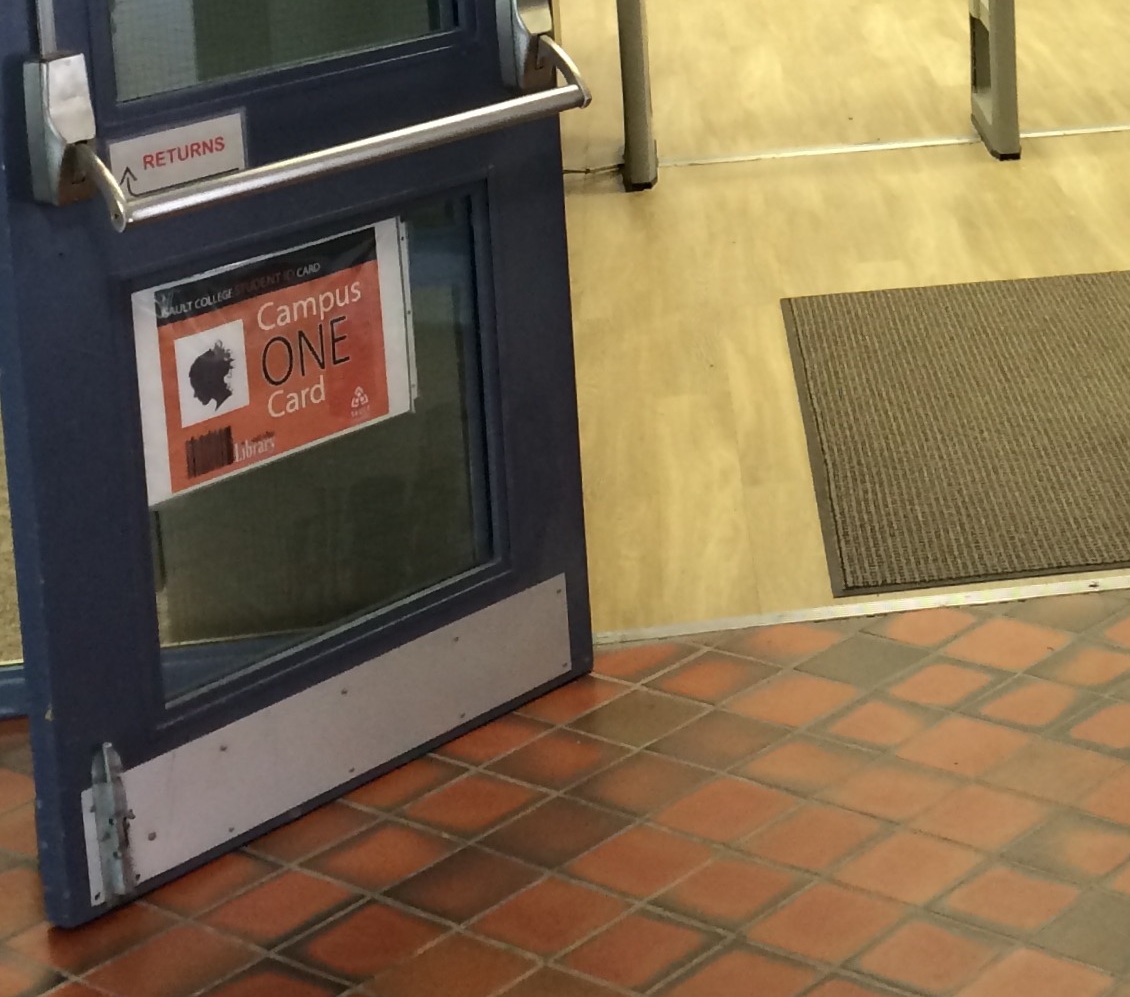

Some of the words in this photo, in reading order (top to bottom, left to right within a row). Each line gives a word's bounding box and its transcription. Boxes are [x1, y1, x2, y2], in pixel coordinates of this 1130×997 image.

[142, 136, 226, 171] RETURNS
[194, 288, 233, 309] COLLEGE
[234, 271, 282, 296] STUDENT
[296, 262, 321, 278] CARD
[257, 280, 362, 331] Campus
[261, 315, 350, 386] ONE
[267, 374, 326, 418] Card
[234, 438, 276, 462] Library
